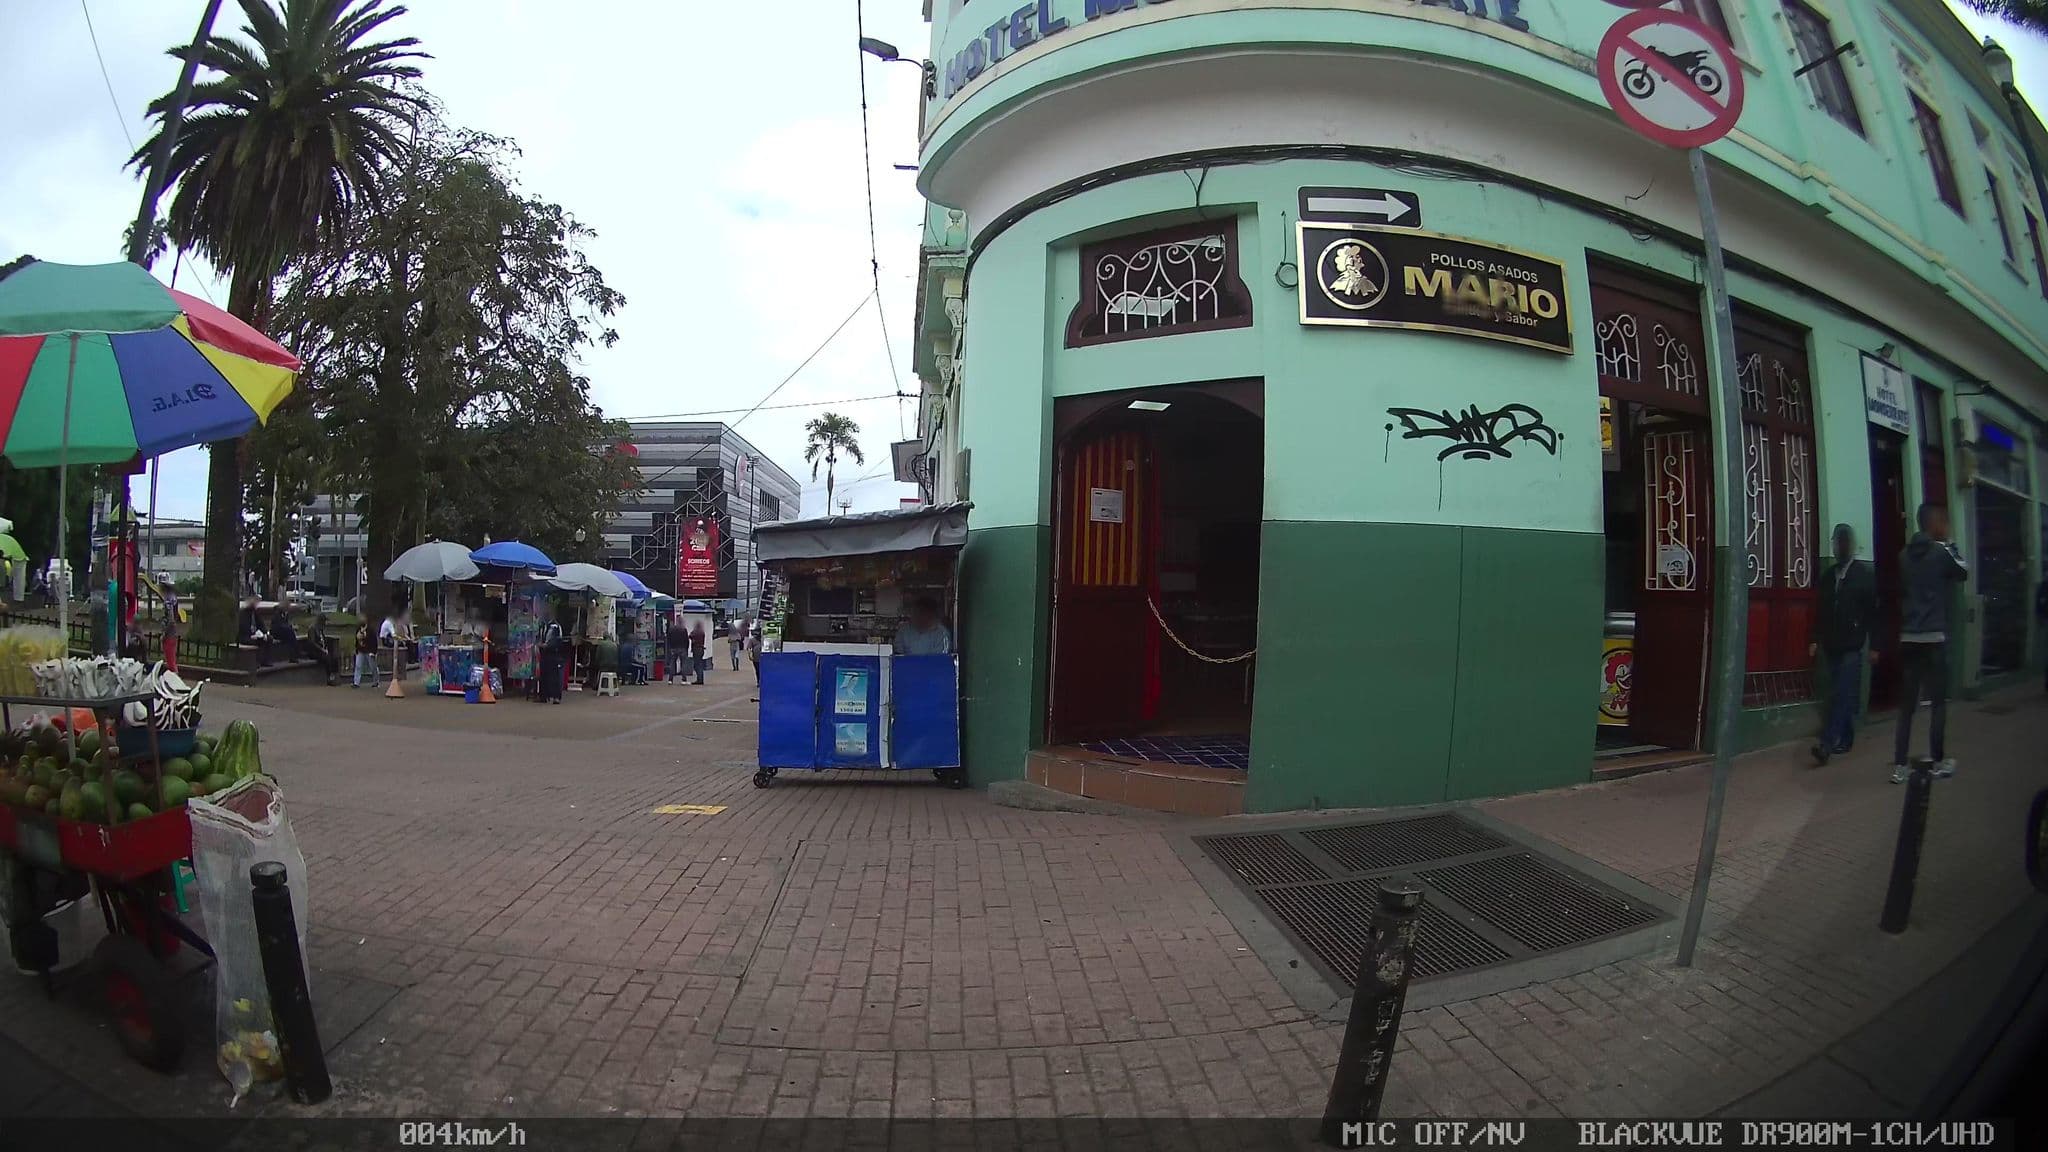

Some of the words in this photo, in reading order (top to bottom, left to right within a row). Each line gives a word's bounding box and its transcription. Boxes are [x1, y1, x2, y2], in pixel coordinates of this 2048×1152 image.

[944, 0, 1070, 99] HOTEL
[1430, 252, 1485, 272] POLLOS
[1488, 262, 1539, 284] ASADOS
[1403, 265, 1560, 319] MARIO
[1505, 311, 1539, 327] Sabor
